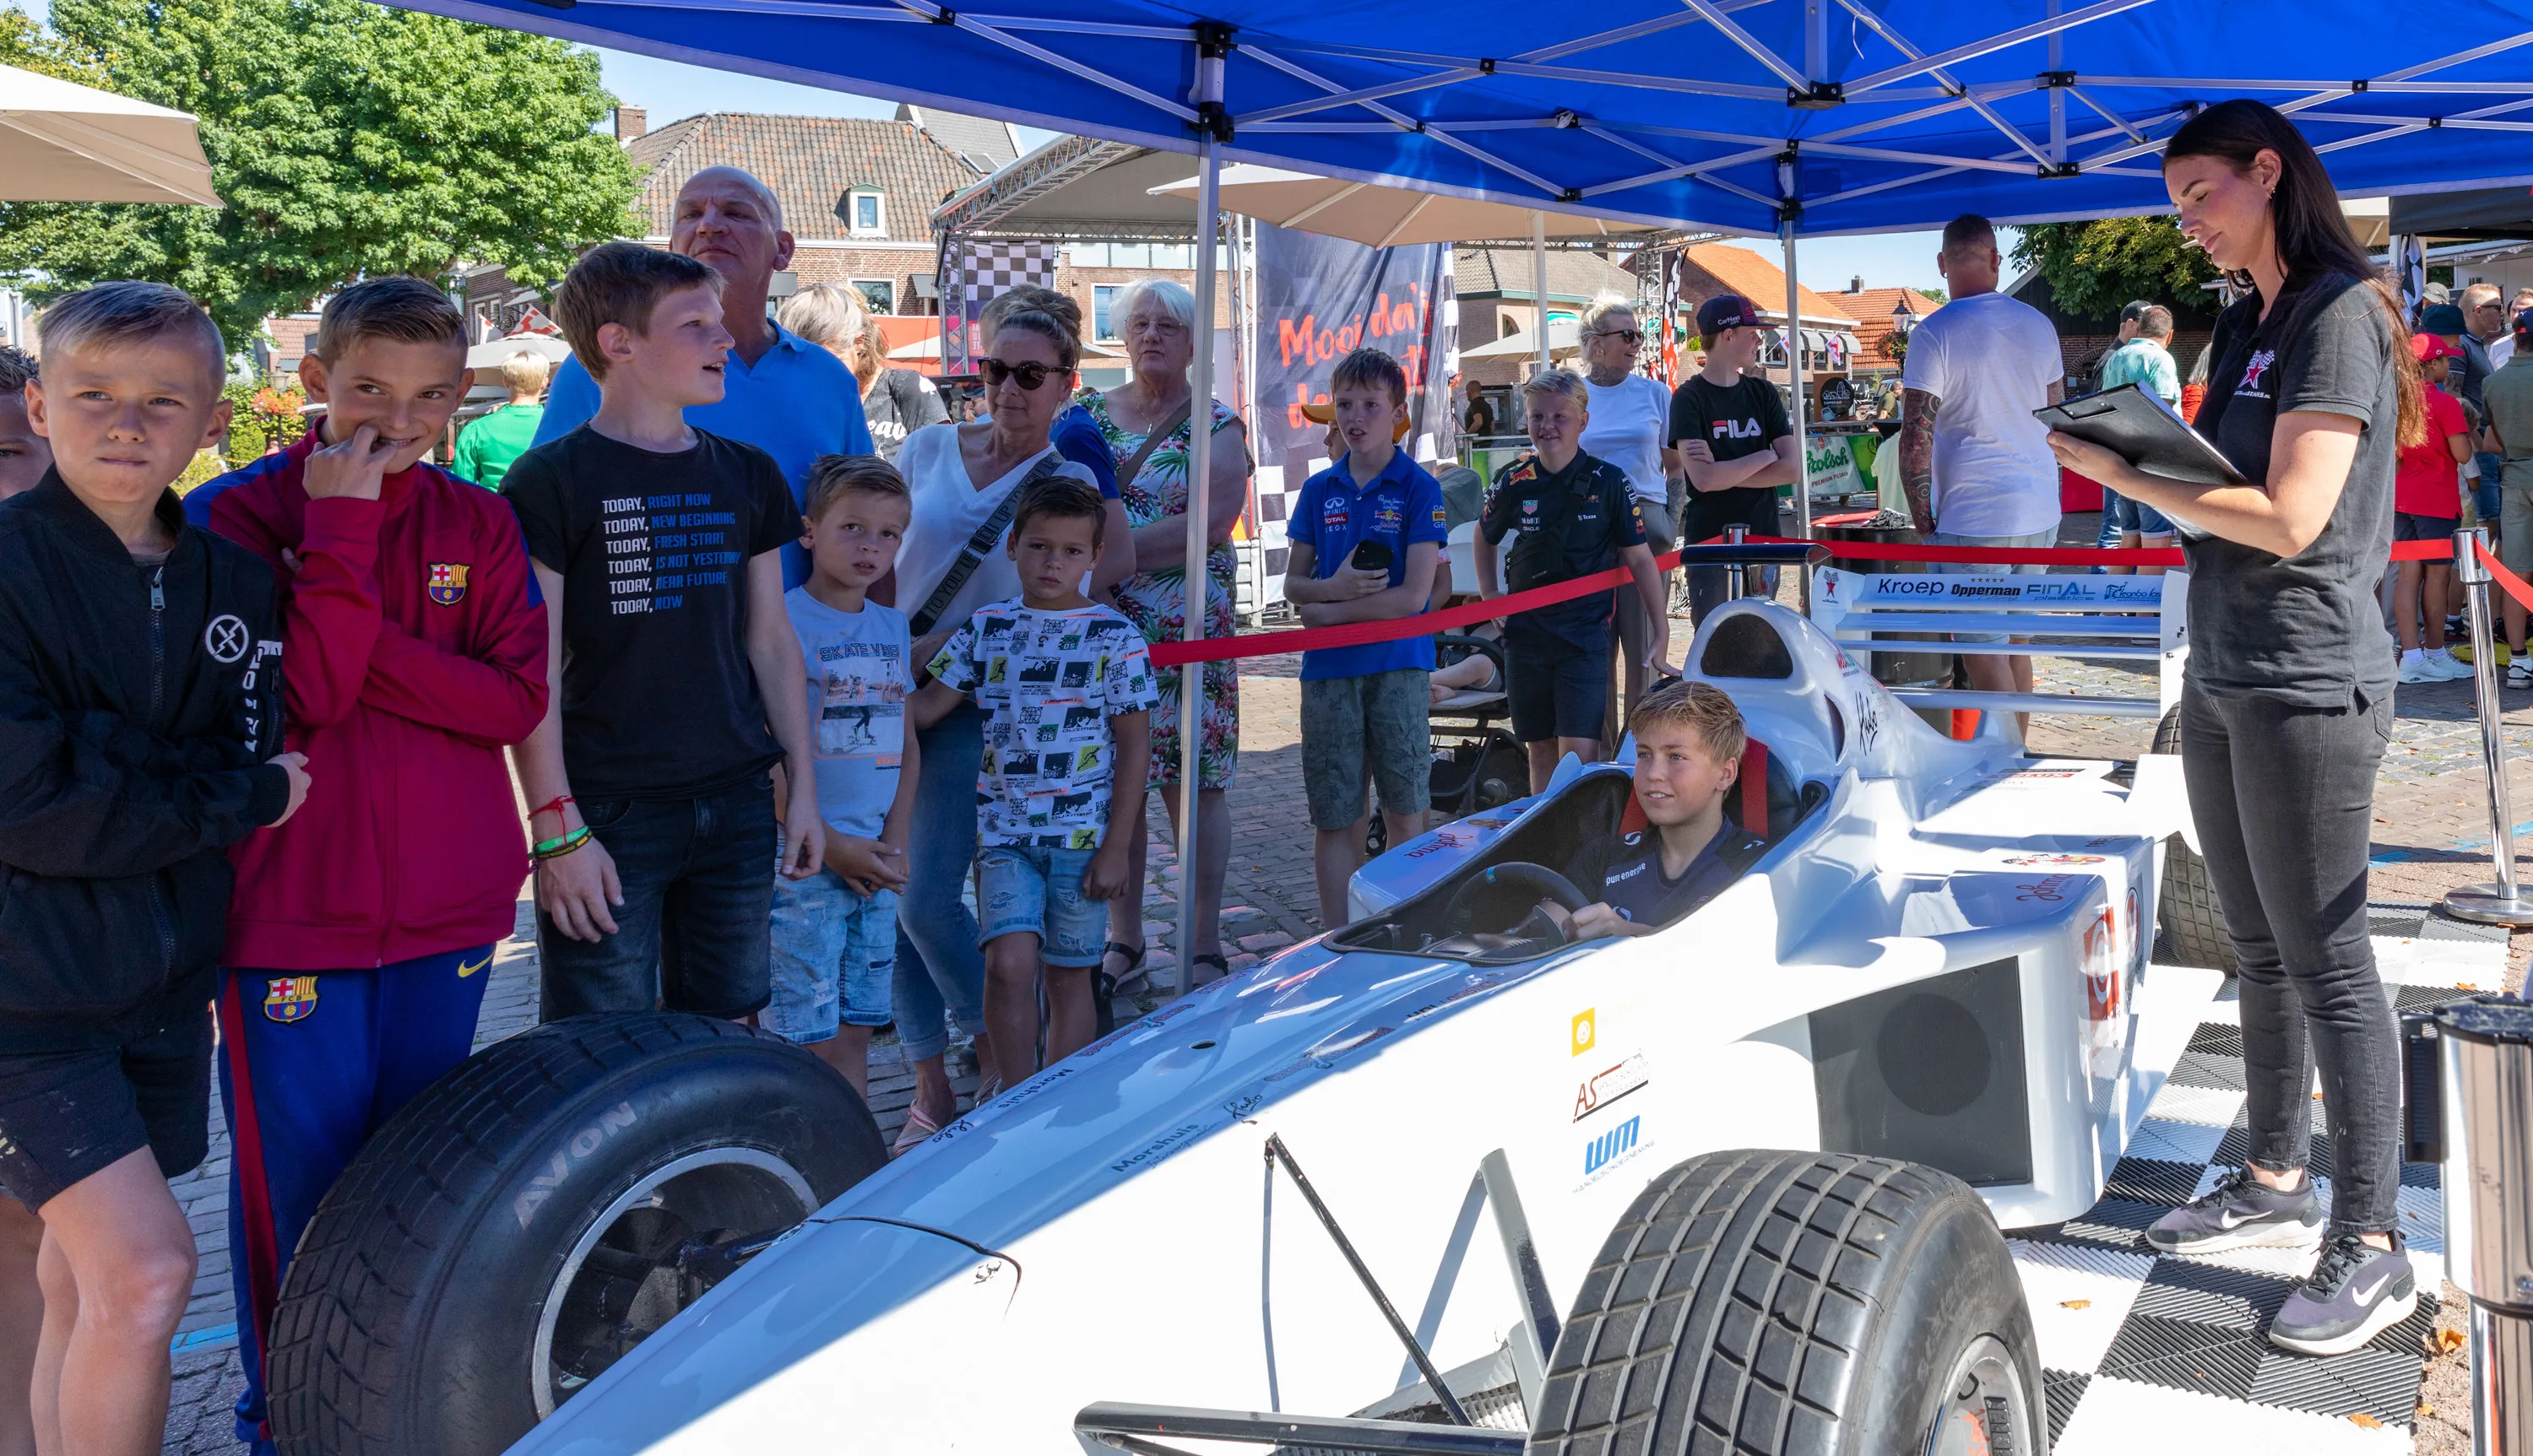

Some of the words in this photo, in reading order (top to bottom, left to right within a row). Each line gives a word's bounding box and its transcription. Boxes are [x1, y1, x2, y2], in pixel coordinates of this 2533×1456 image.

[1278, 314, 1363, 367] Mooi
[1712, 418, 1762, 439] FILA
[1811, 475, 1833, 488] PREMIUM
[602, 497, 646, 513] TODAY,
[647, 494, 682, 509] RIGHT
[685, 493, 711, 507] NOW
[603, 516, 649, 534] TODAY,
[651, 515, 676, 529] NEW
[679, 511, 736, 528] BEGINNING
[1325, 516, 1347, 524] TOTAL
[605, 537, 651, 554] TODAY,
[654, 534, 687, 549] FRESH
[690, 532, 725, 546] START
[608, 557, 653, 574] TODAY,
[655, 555, 665, 570] IS
[668, 554, 689, 569] NOT
[610, 577, 653, 594] TODAY,
[655, 575, 684, 590] NEAR
[686, 571, 728, 587] FUTURE
[941, 570, 964, 595] YOU
[1878, 578, 1944, 596] Kroep
[1950, 583, 2021, 597] Opperman
[611, 598, 654, 614] TODAY,
[654, 594, 683, 610] NOW
[820, 642, 869, 662] SKATE
[1606, 874, 1620, 887] pure
[1621, 862, 1646, 880] energie
[1111, 1123, 1199, 1172] Morshuis
[514, 1101, 637, 1231] AVON
[1572, 1141, 1656, 1195] HANDELSONDERNEMING
